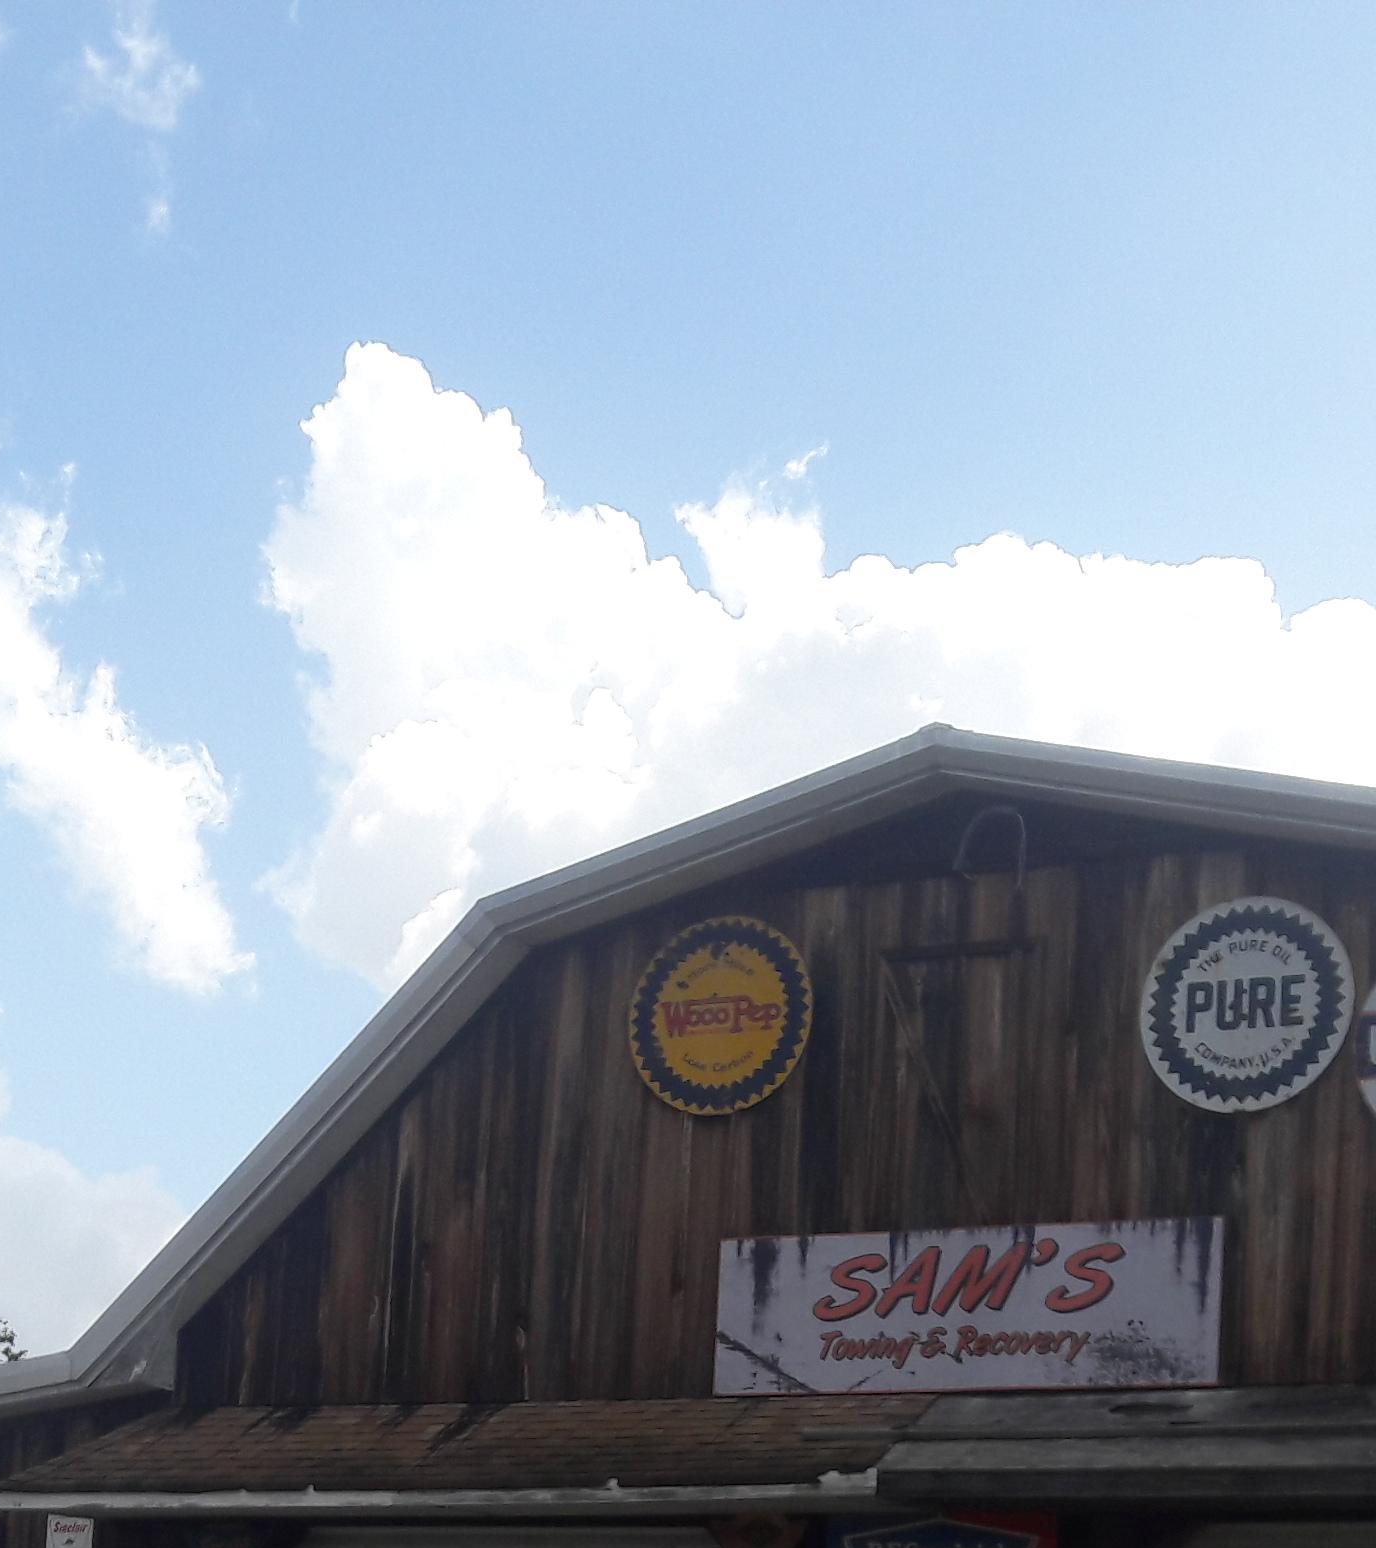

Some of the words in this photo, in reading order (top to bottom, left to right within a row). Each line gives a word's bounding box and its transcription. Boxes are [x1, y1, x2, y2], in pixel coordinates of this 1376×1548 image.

[1229, 939, 1268, 954] PURE
[1272, 945, 1292, 965] OIL
[1186, 974, 1305, 1033] PURE
[812, 1237, 1126, 1322] SAM'S
[818, 1331, 915, 1369] Towing
[920, 1327, 948, 1359] &
[956, 1325, 1092, 1365] Recovery
